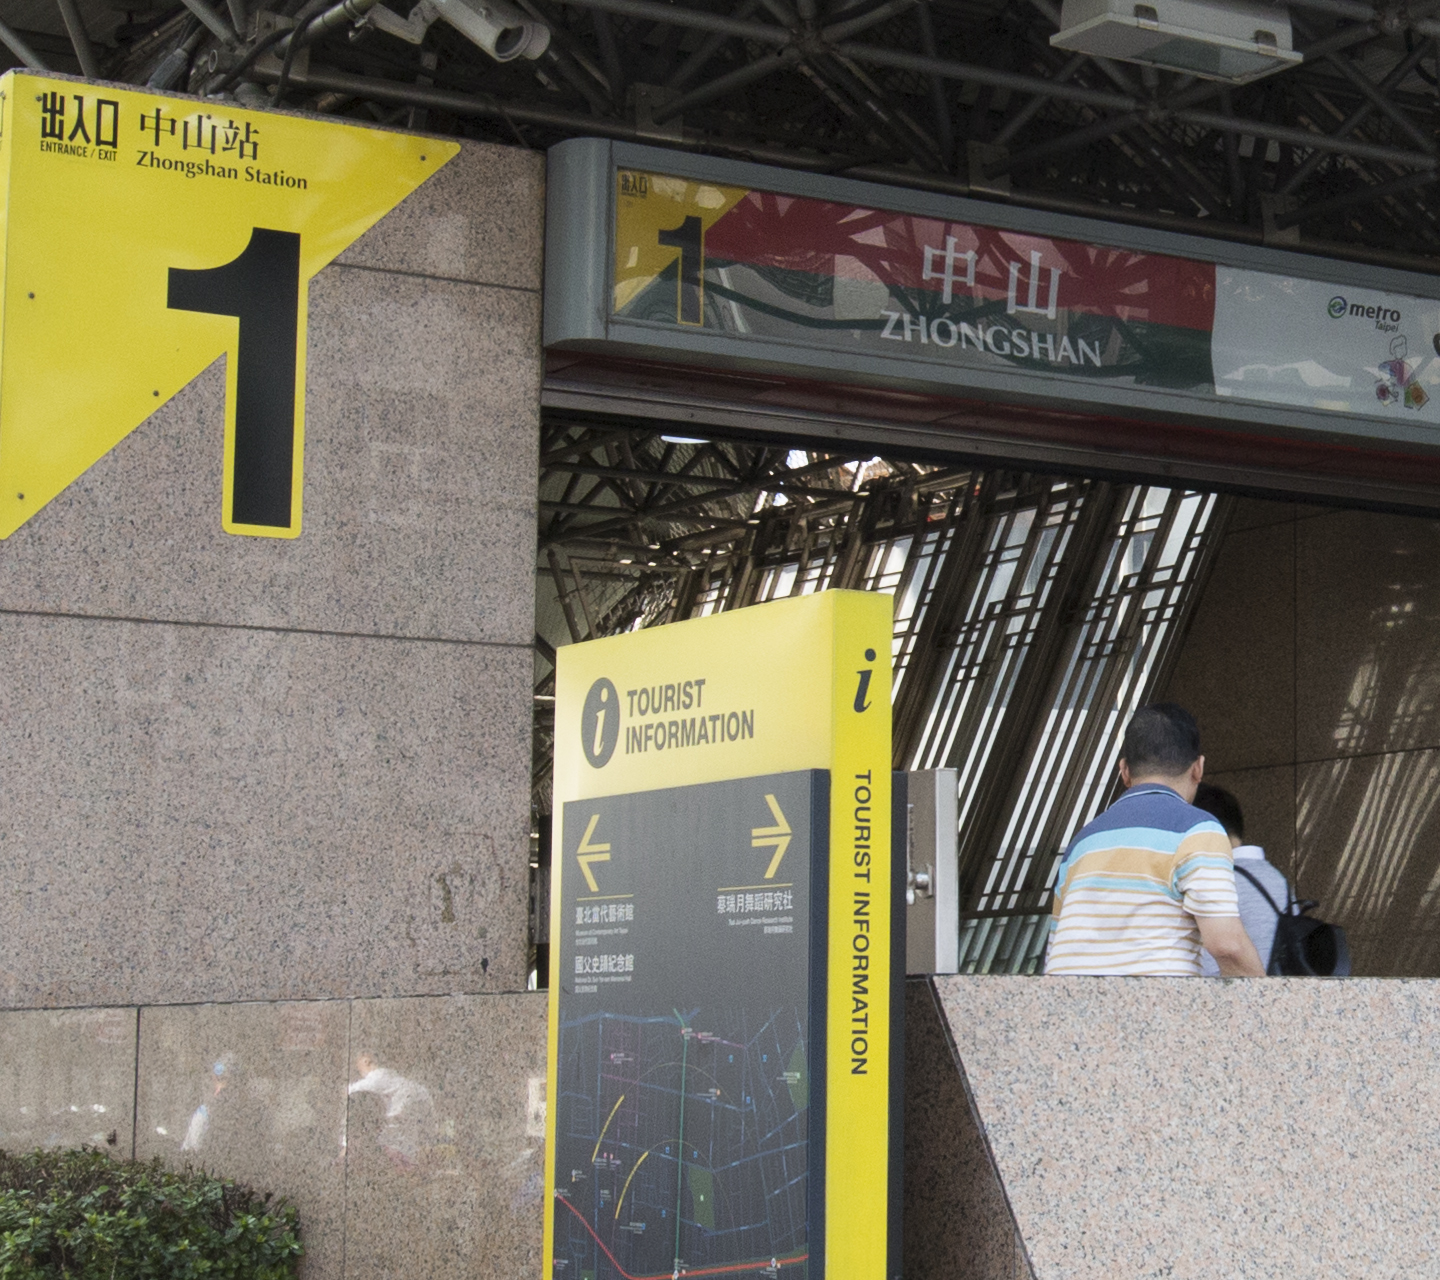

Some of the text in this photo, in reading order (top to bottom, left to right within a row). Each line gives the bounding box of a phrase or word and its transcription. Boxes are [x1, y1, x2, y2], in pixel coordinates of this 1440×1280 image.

[40, 91, 259, 161] 出入口 中山站
[40, 140, 88, 158] ENTRANCE
[98, 149, 118, 162] EXIT
[135, 149, 309, 190] Zhongshan Station
[621, 174, 648, 195] 出入口
[658, 215, 703, 324] 1
[922, 236, 1063, 320] 中山
[1348, 301, 1402, 324] metro
[1374, 319, 1400, 335] Taipei
[880, 310, 1102, 368] ZHONGSHAN
[166, 226, 301, 528] 1
[627, 678, 706, 717] TOURIST
[625, 709, 754, 755] INFORMATION
[717, 890, 793, 914] 蔡瑞月舞蹈研究社
[850, 769, 872, 1076] TOURIST INFORMATION
[574, 954, 635, 974] 國父史蹟紀念館
